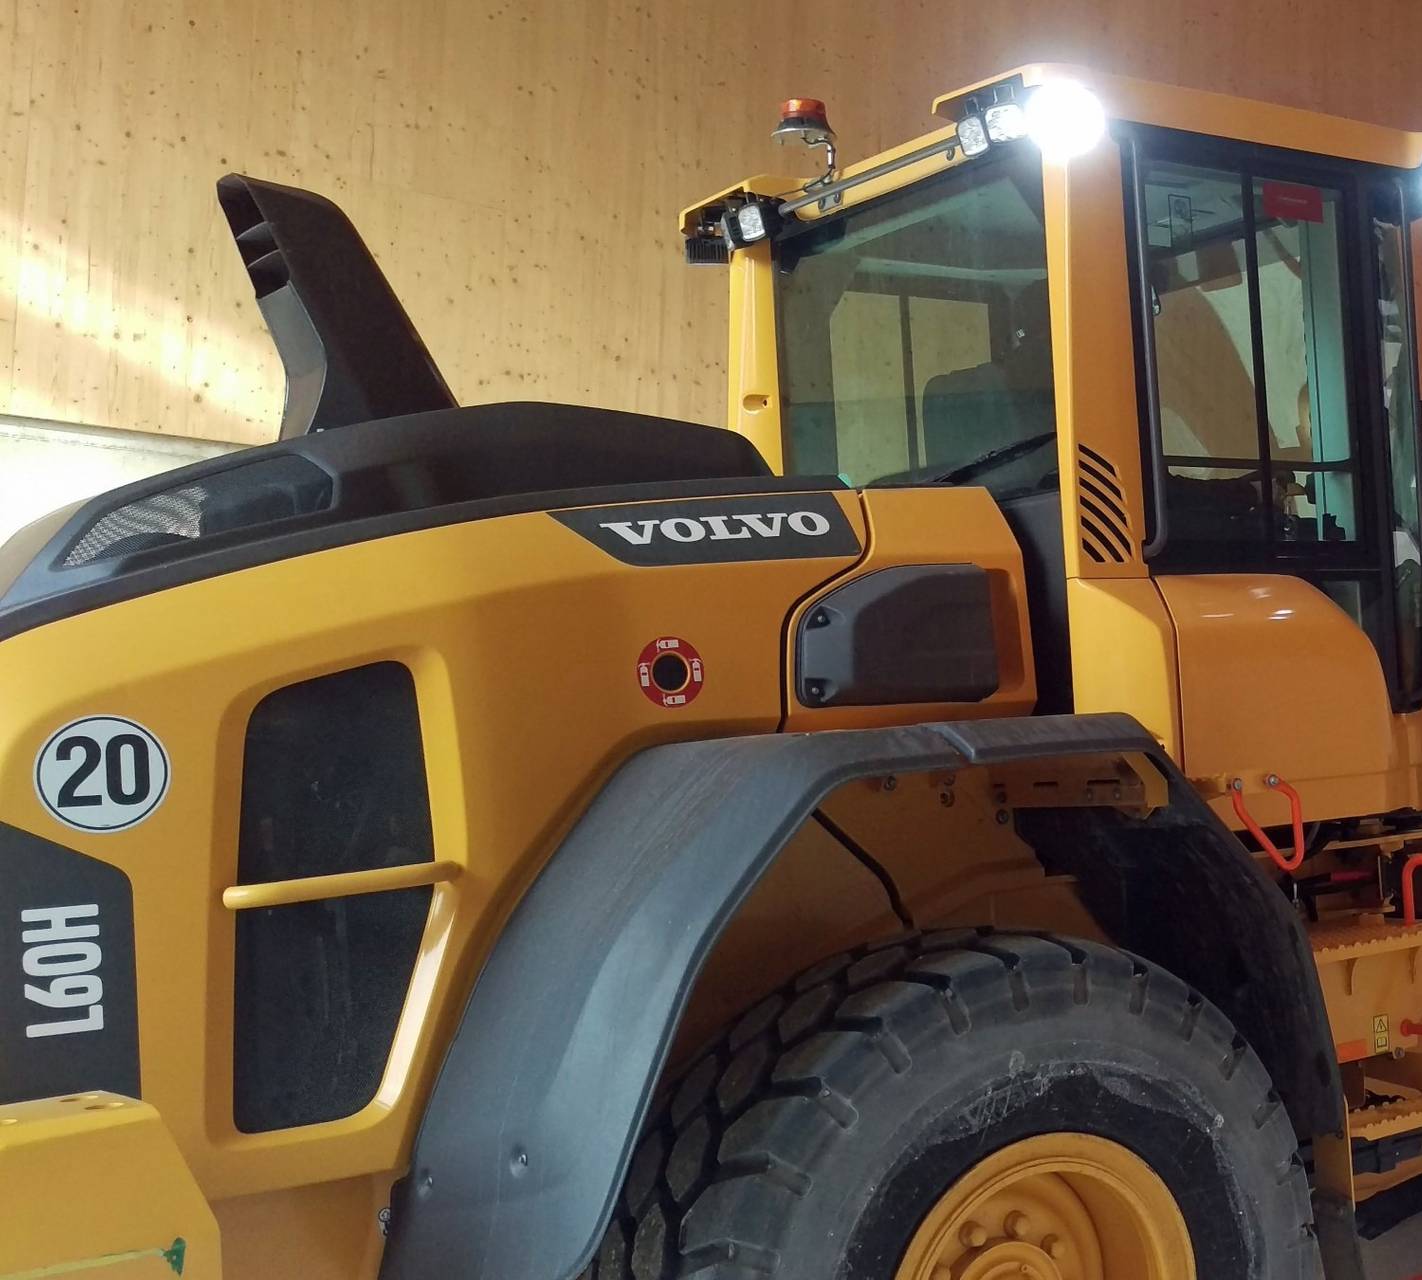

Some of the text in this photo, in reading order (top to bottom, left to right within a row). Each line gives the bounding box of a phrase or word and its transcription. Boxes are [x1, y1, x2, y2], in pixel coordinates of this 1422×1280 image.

[599, 511, 830, 545] VOLVO
[56, 734, 150, 808] 20
[21, 904, 104, 1038] L60H
